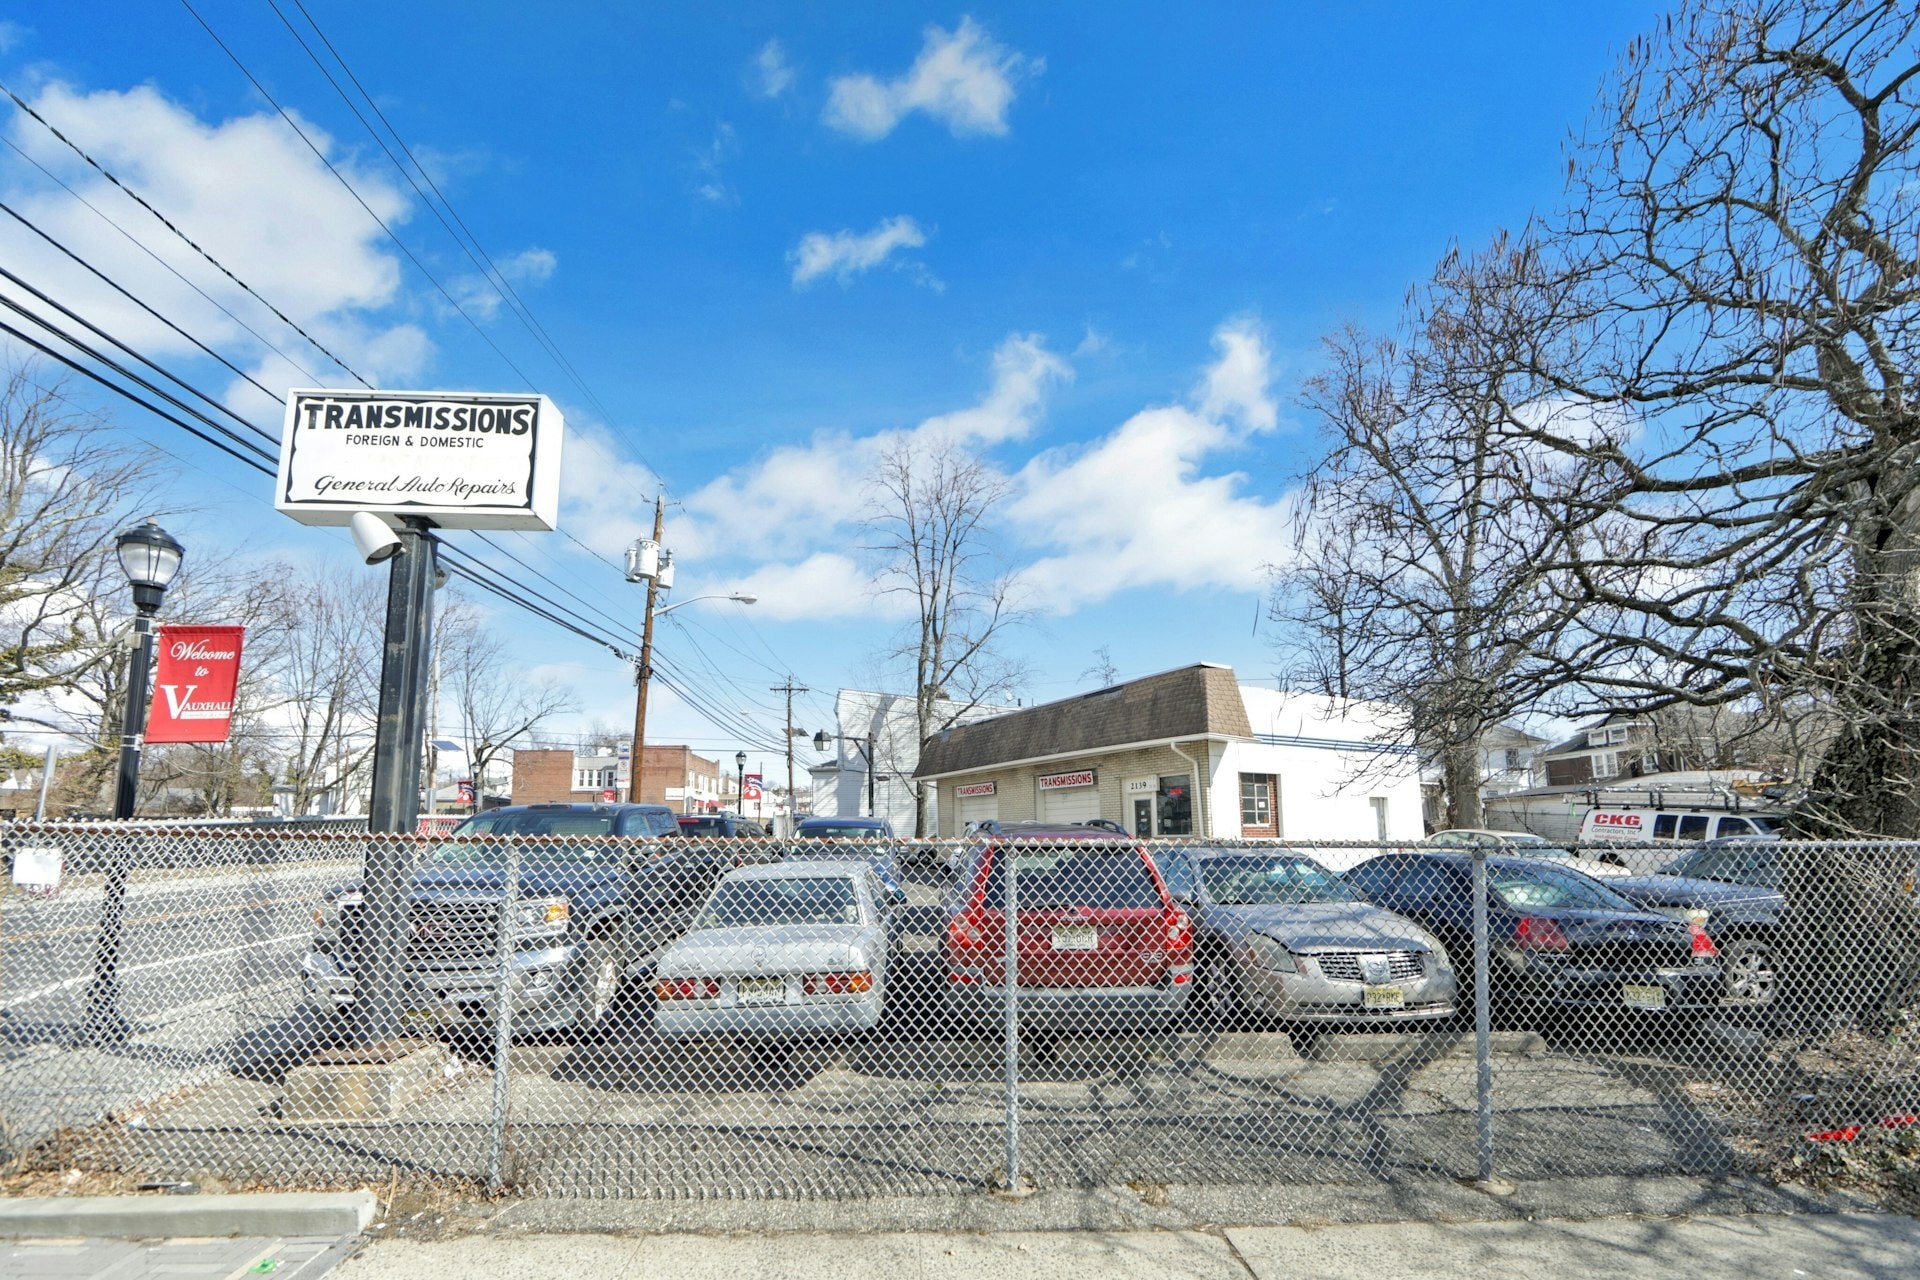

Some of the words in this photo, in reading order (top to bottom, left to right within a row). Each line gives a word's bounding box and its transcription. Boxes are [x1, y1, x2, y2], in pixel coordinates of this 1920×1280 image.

[304, 403, 530, 436] TRANSMISSIONS
[346, 434, 400, 447] FOREIGN
[405, 436, 414, 447] &
[420, 436, 484, 449] DOMESTIC
[314, 475, 400, 496] General
[396, 475, 446, 493] Auto
[445, 477, 516, 500] Repairs
[170, 639, 235, 660] Welcome
[194, 665, 210, 677] to
[160, 684, 231, 720] VAUXHALL
[1040, 773, 1092, 788] TRANSMISSIONS
[1130, 781, 1147, 790] 2139
[1594, 813, 1640, 826] CKG
